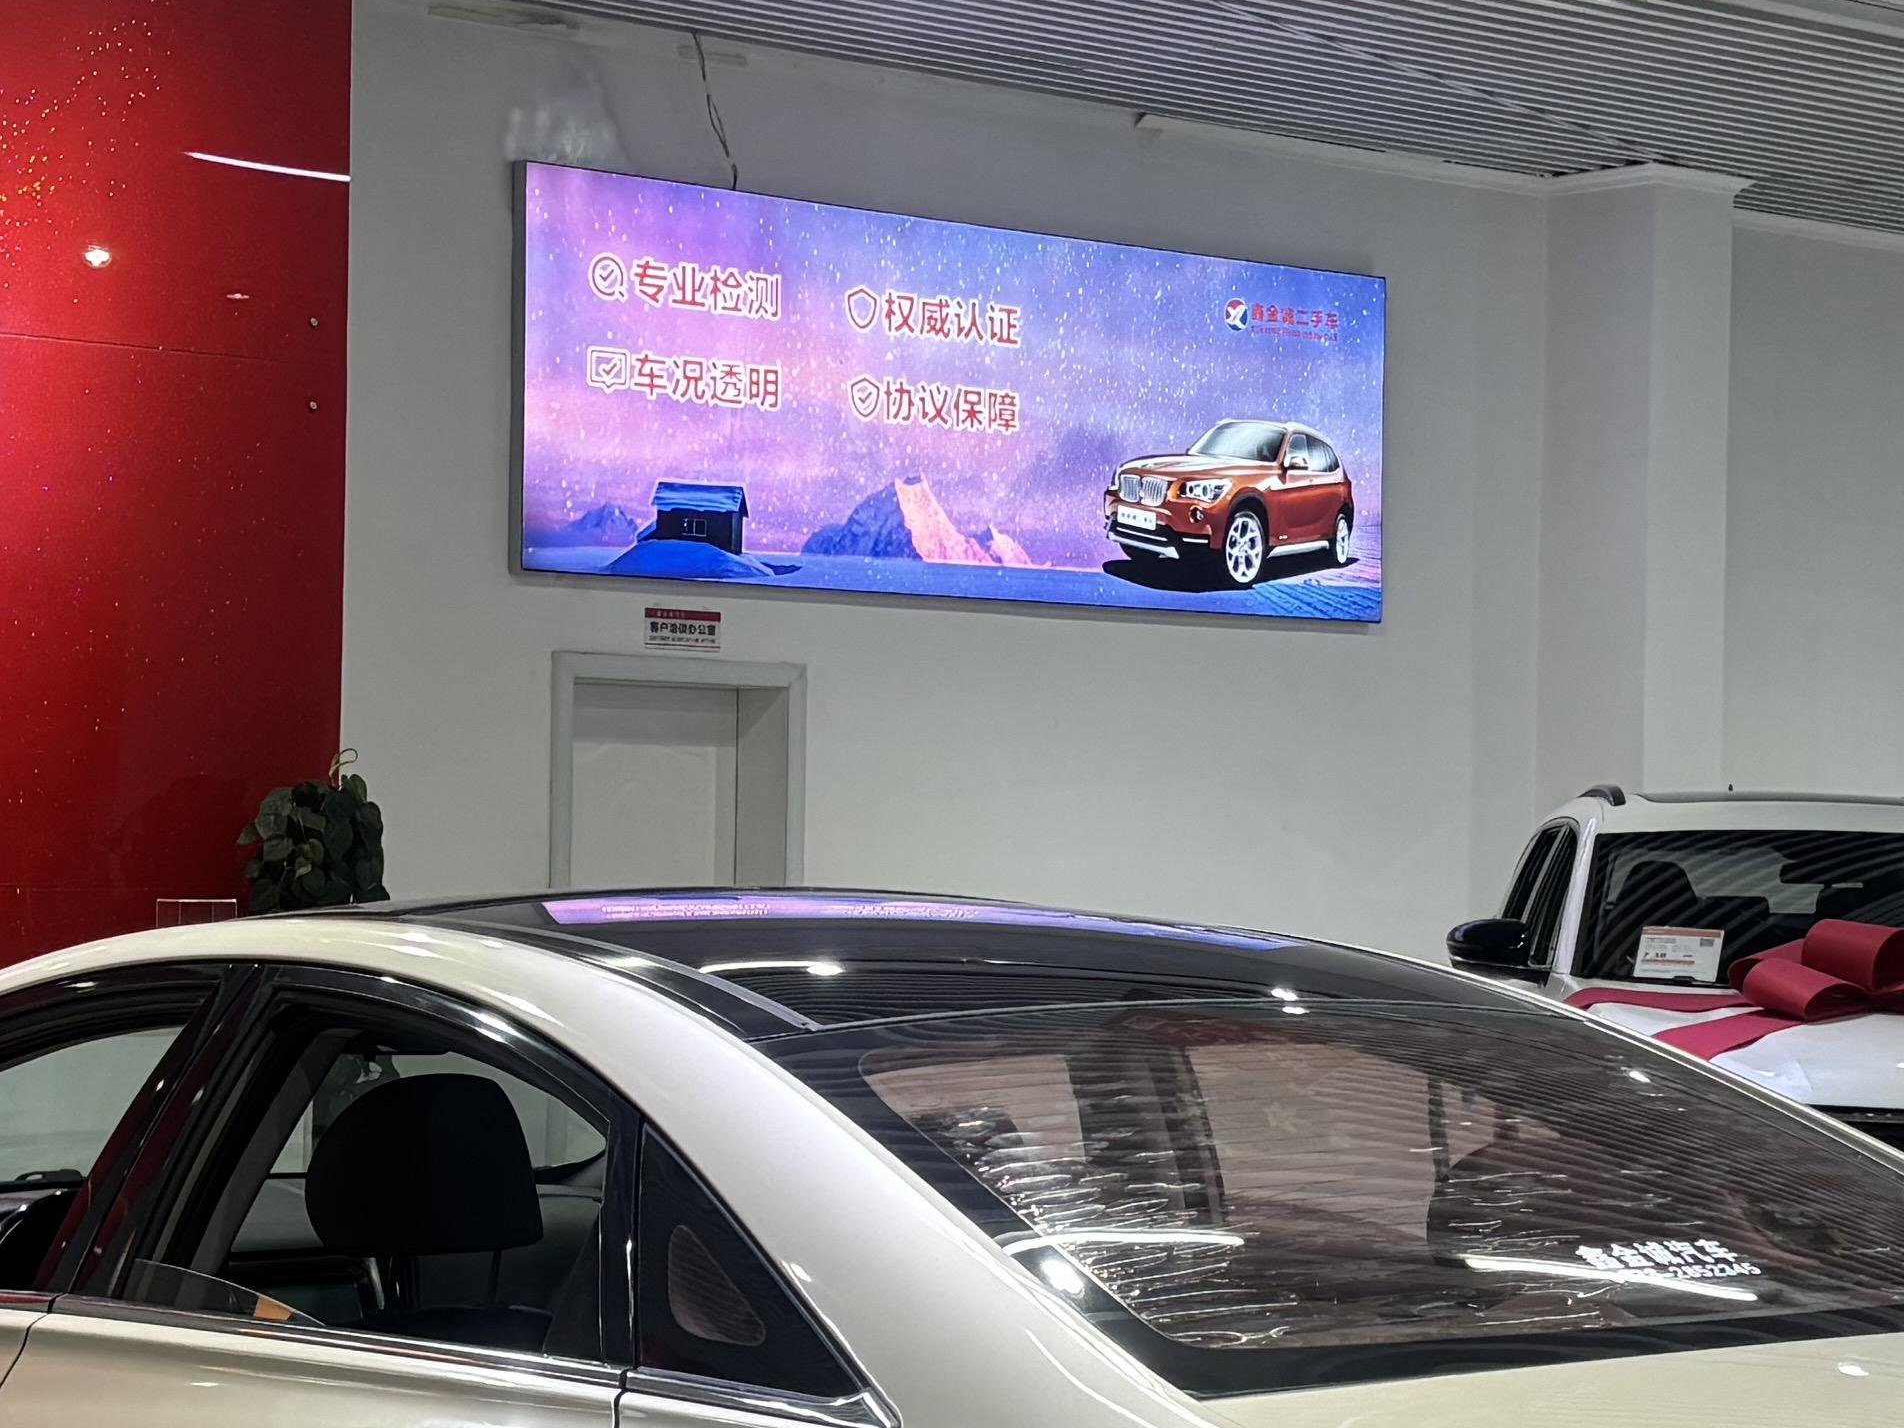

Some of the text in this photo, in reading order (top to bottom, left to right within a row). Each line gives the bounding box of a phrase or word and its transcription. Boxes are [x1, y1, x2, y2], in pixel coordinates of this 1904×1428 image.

[632, 258, 1021, 349] 专业检测 权威认证
[631, 352, 1020, 435] 车况透明 协议保障
[1576, 1238, 1738, 1269] 鑫金诚汽车
